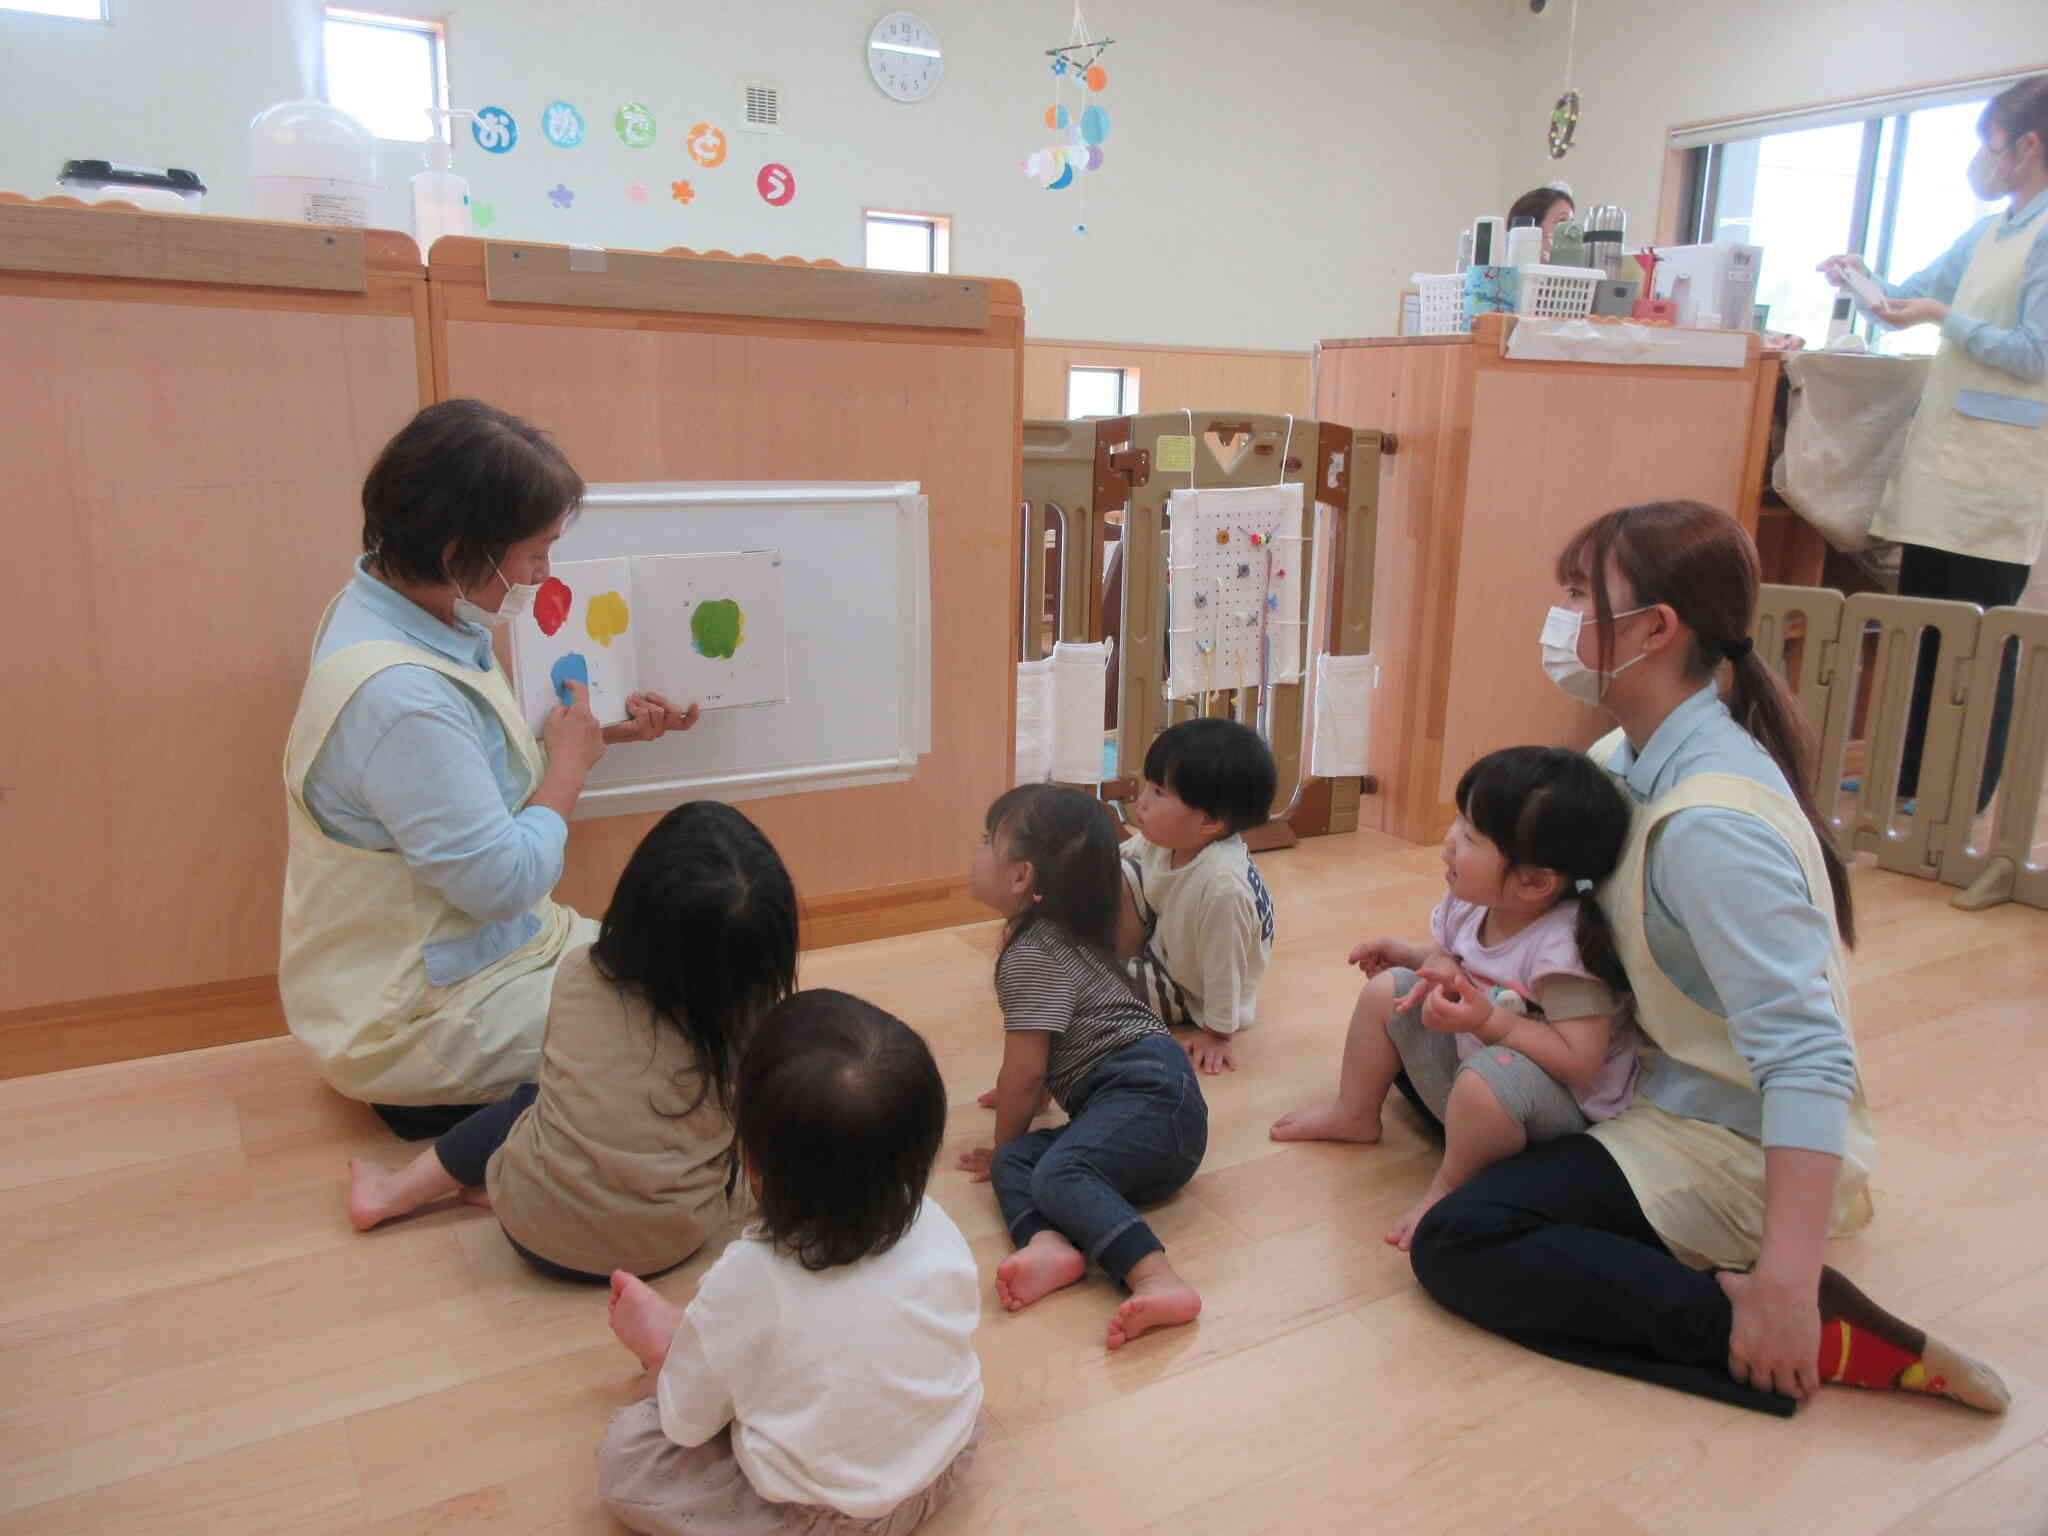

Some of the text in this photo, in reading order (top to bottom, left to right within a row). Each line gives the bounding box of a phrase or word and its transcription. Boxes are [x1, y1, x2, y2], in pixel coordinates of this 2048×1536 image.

[481, 103, 787, 201] おめでとう
